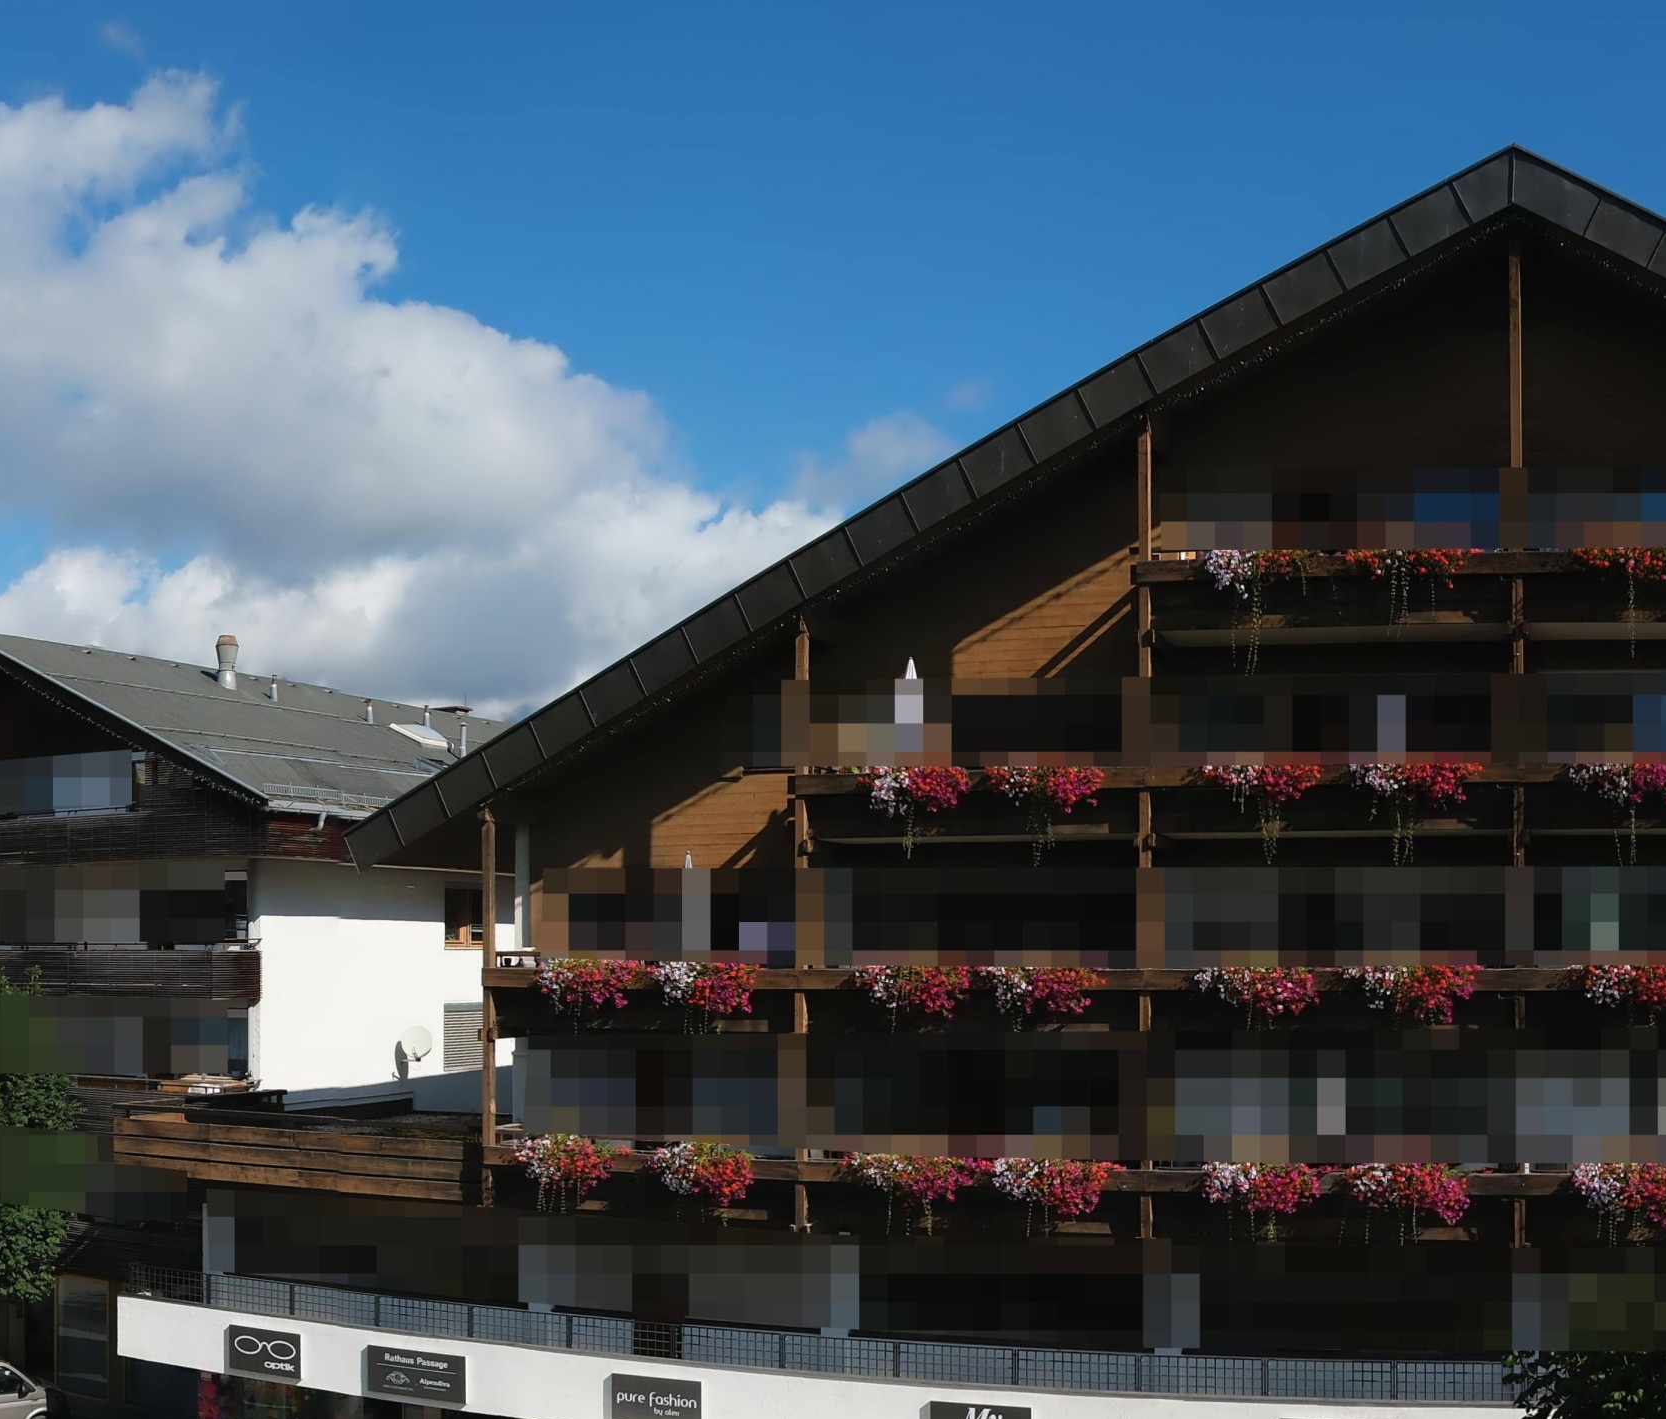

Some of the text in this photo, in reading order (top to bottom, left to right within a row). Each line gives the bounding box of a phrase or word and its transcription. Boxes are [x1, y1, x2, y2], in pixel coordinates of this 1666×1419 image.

[264, 1361, 295, 1373] optik
[384, 1353, 448, 1370] Rathaus Passage
[616, 1391, 697, 1409] pure fashion
[653, 1407, 664, 1417] by
